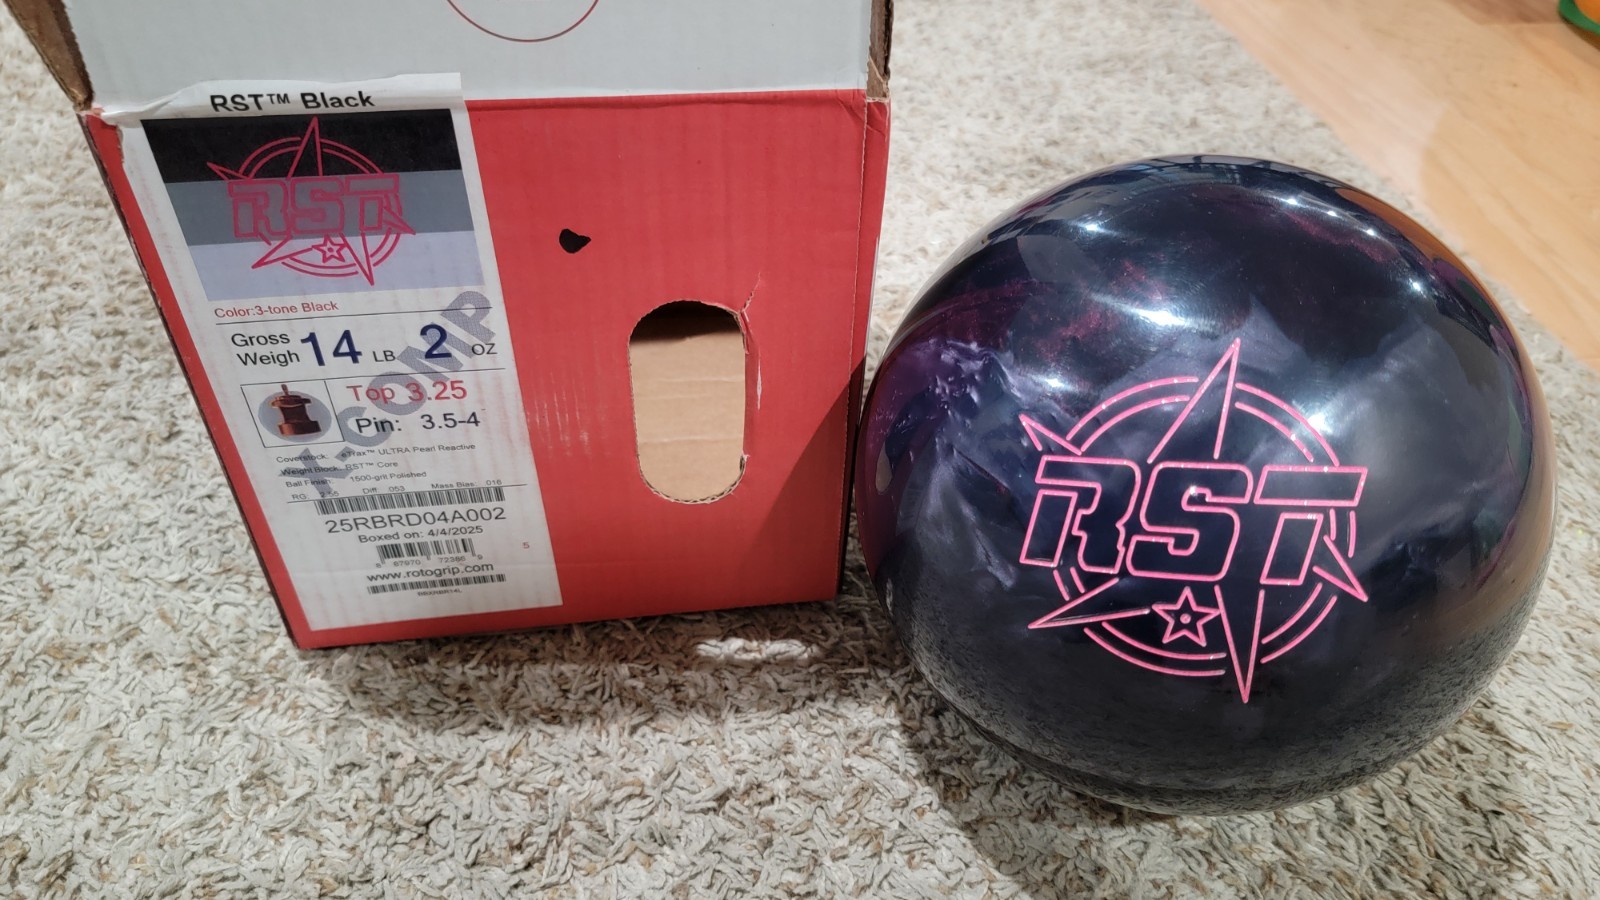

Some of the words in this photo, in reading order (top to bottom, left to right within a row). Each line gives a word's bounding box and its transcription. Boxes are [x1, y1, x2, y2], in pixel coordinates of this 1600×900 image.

[300, 91, 376, 109] Black
[227, 174, 400, 239] RST
[301, 301, 339, 312] Black
[231, 333, 290, 347] Gross
[301, 329, 362, 367] 14
[373, 350, 396, 362] LB
[420, 324, 452, 359] 2
[471, 343, 498, 356] OZ
[236, 350, 300, 367] Weigh
[347, 385, 395, 404] Top
[406, 380, 467, 401] 3.25
[355, 417, 402, 434] Pin:
[420, 411, 480, 430] 3.5-4
[378, 447, 411, 455] ULTRA
[413, 445, 436, 453] Pearl
[438, 443, 476, 452] Reactive
[280, 467, 312, 476] Weight
[390, 471, 427, 479] Polished
[325, 506, 507, 534] 25RBRD04A002
[1019, 454, 1369, 586] RST
[358, 531, 400, 543] Boxed
[404, 530, 424, 539] on:
[427, 525, 483, 537] 4/4/2025
[367, 563, 494, 582] www.rotogrip.com
